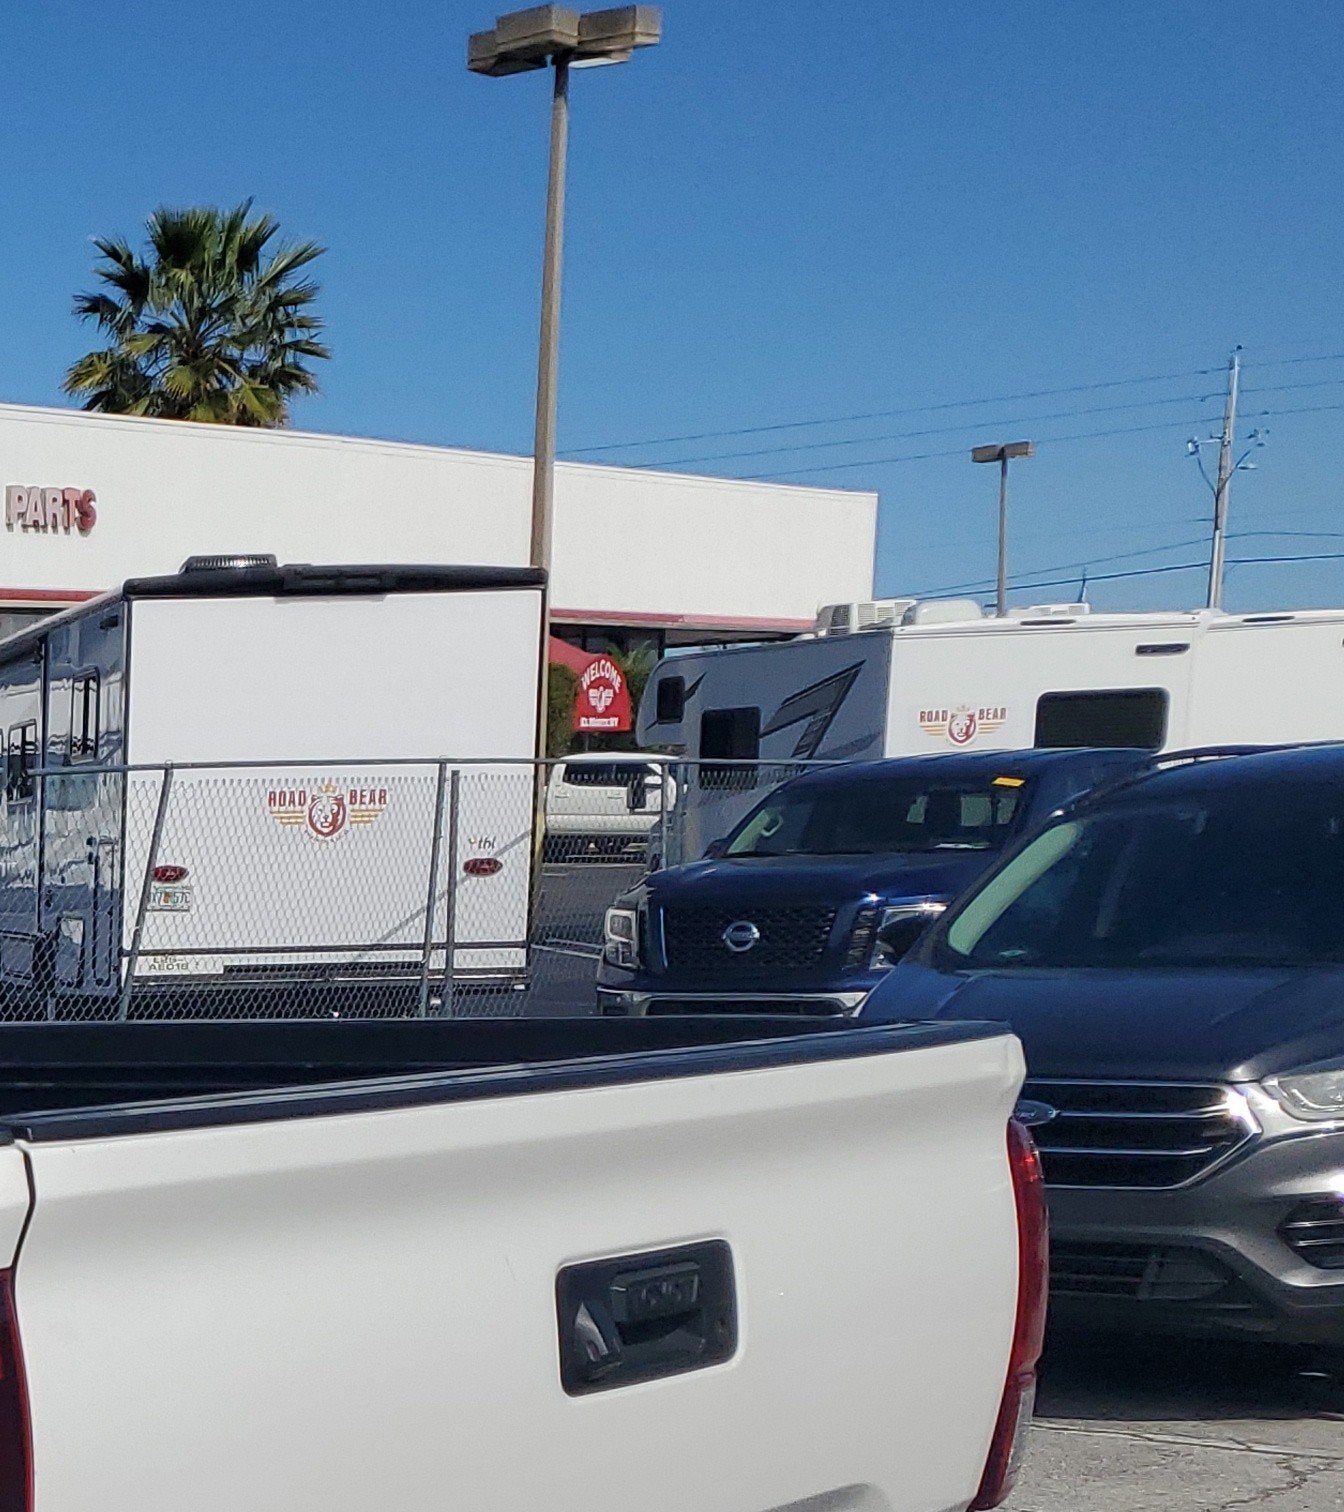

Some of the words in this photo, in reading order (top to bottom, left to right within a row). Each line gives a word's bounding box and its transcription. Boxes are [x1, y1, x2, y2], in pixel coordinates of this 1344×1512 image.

[6, 485, 97, 537] PARTS
[581, 659, 622, 693] WELCOME
[919, 709, 949, 722] ROAD
[978, 707, 1007, 721] BEAR
[268, 790, 307, 808] ROAD
[348, 788, 388, 806] BEAR
